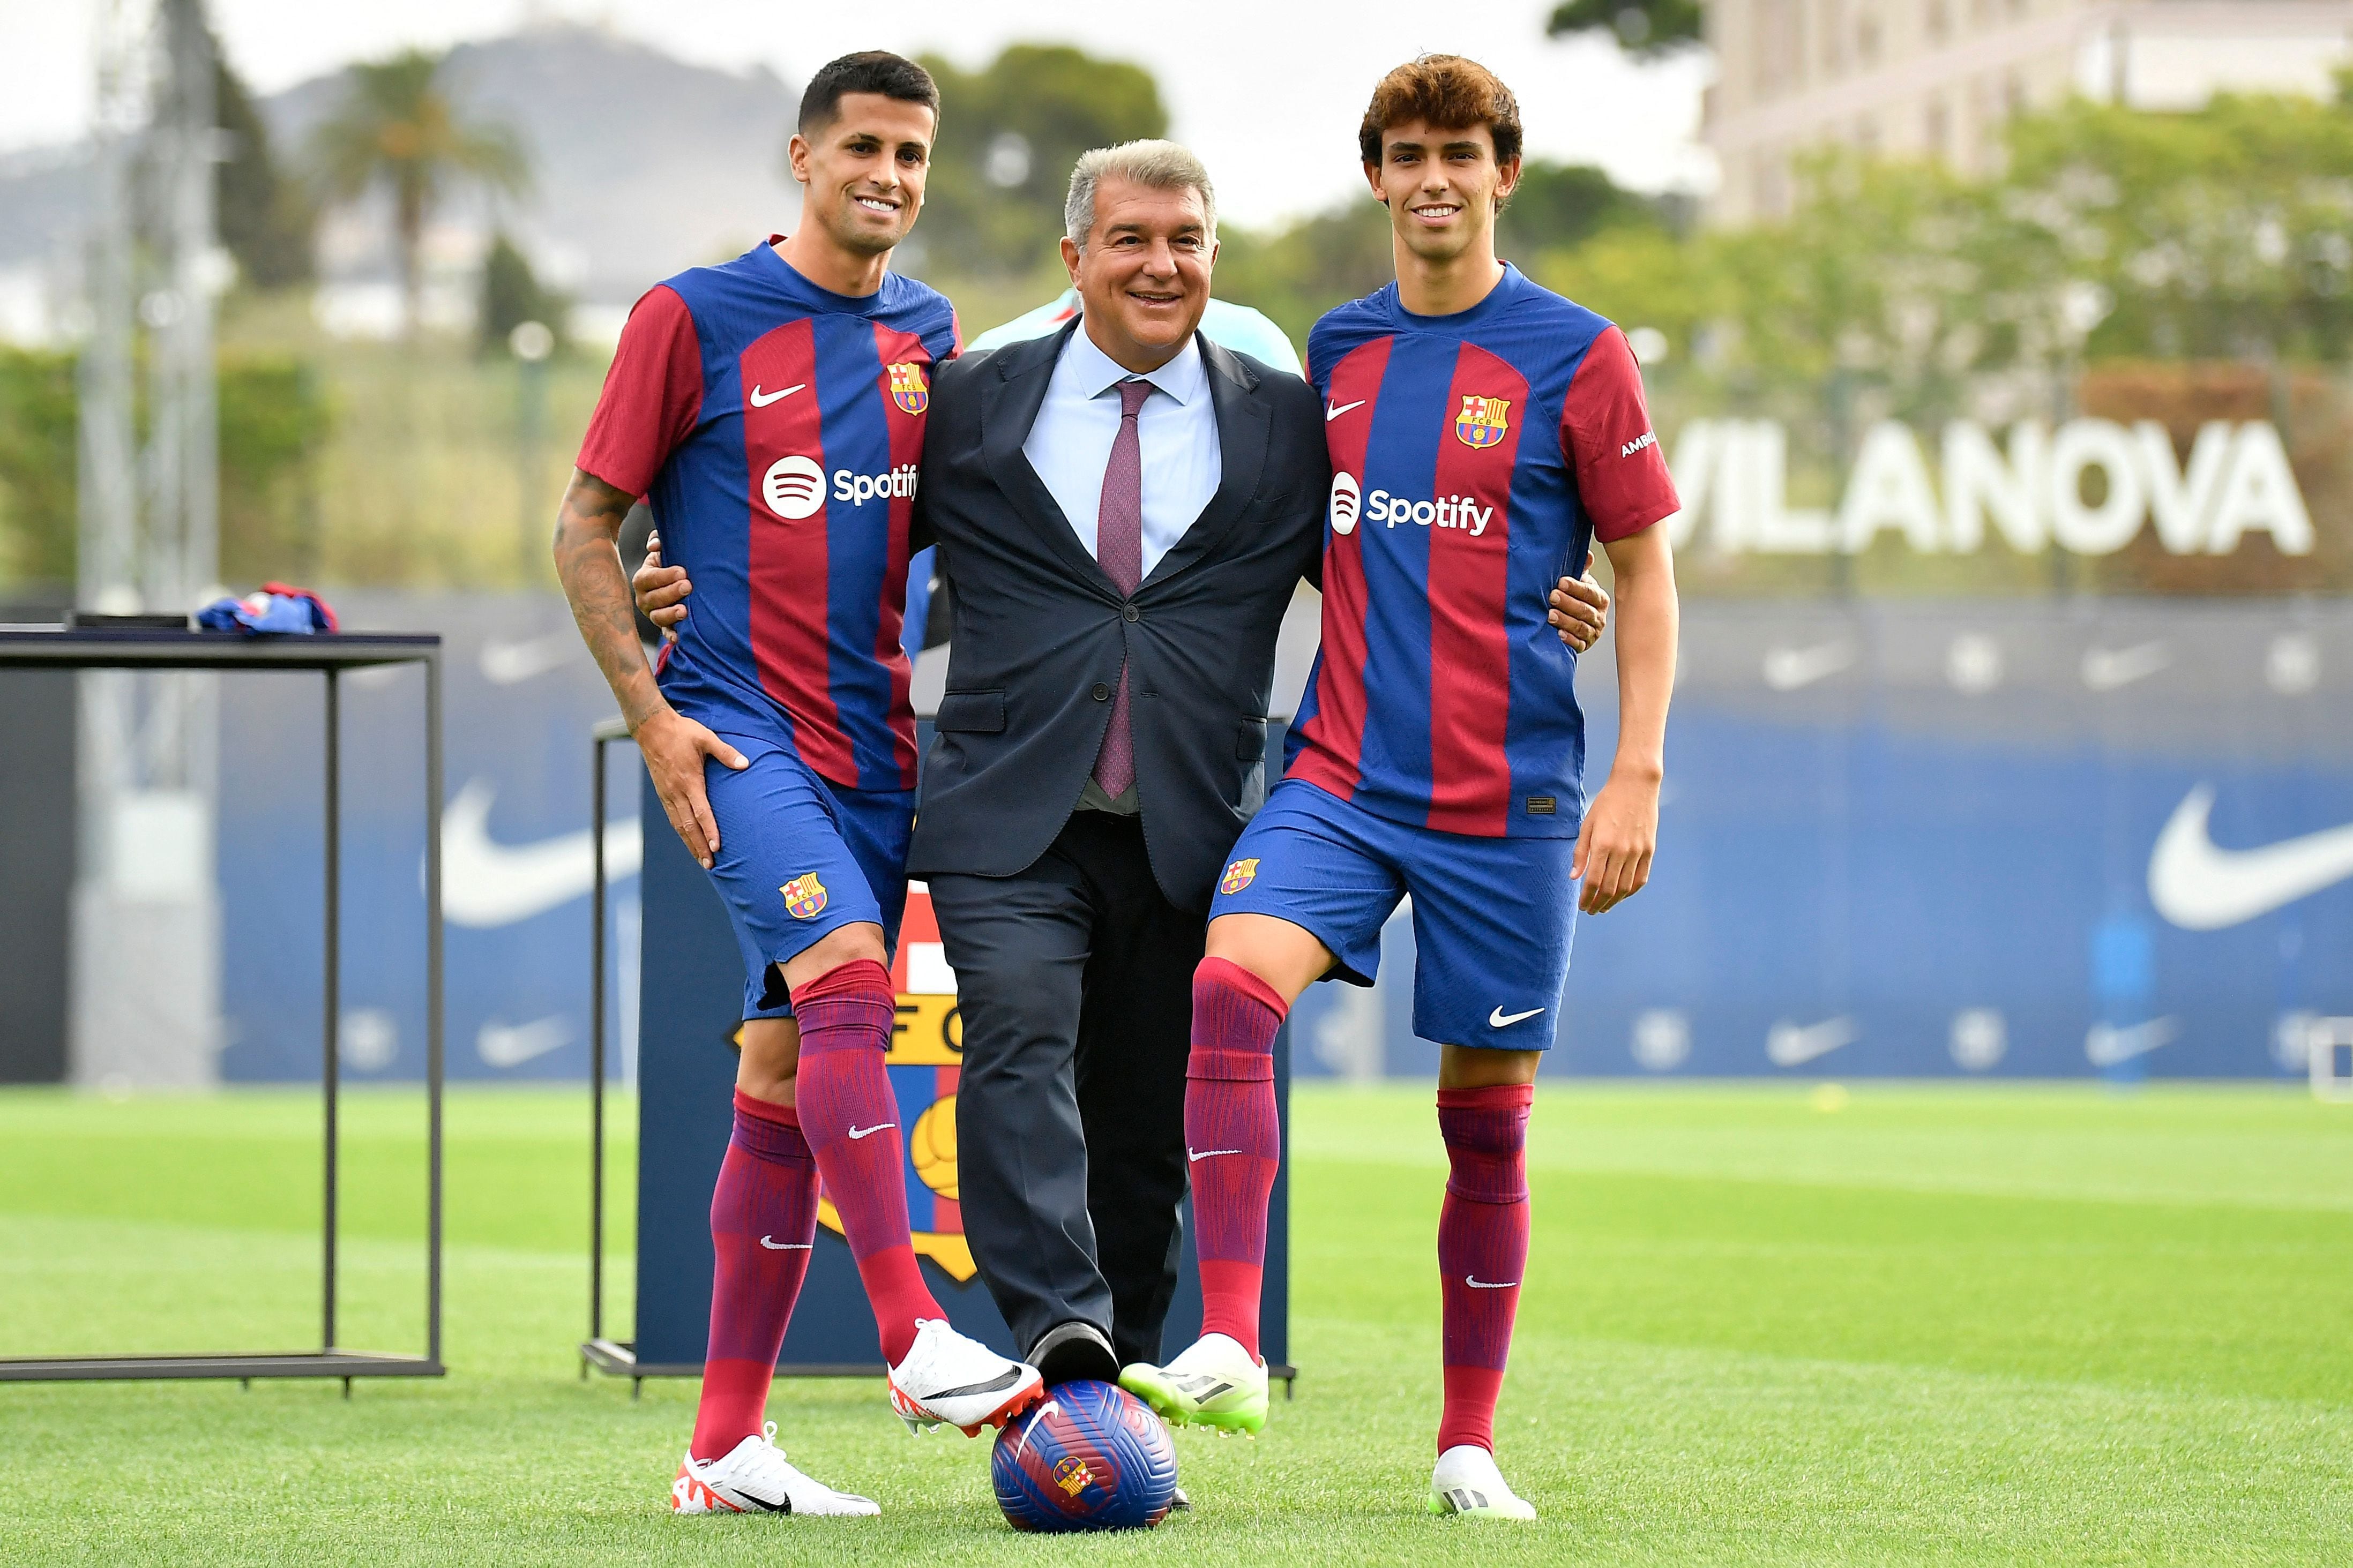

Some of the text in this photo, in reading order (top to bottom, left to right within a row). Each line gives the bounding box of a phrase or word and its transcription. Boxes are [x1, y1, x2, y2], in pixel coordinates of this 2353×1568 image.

[833, 463, 919, 506] Spotify
[1366, 490, 1493, 536] Spotify
[797, 891, 812, 901] FCB
